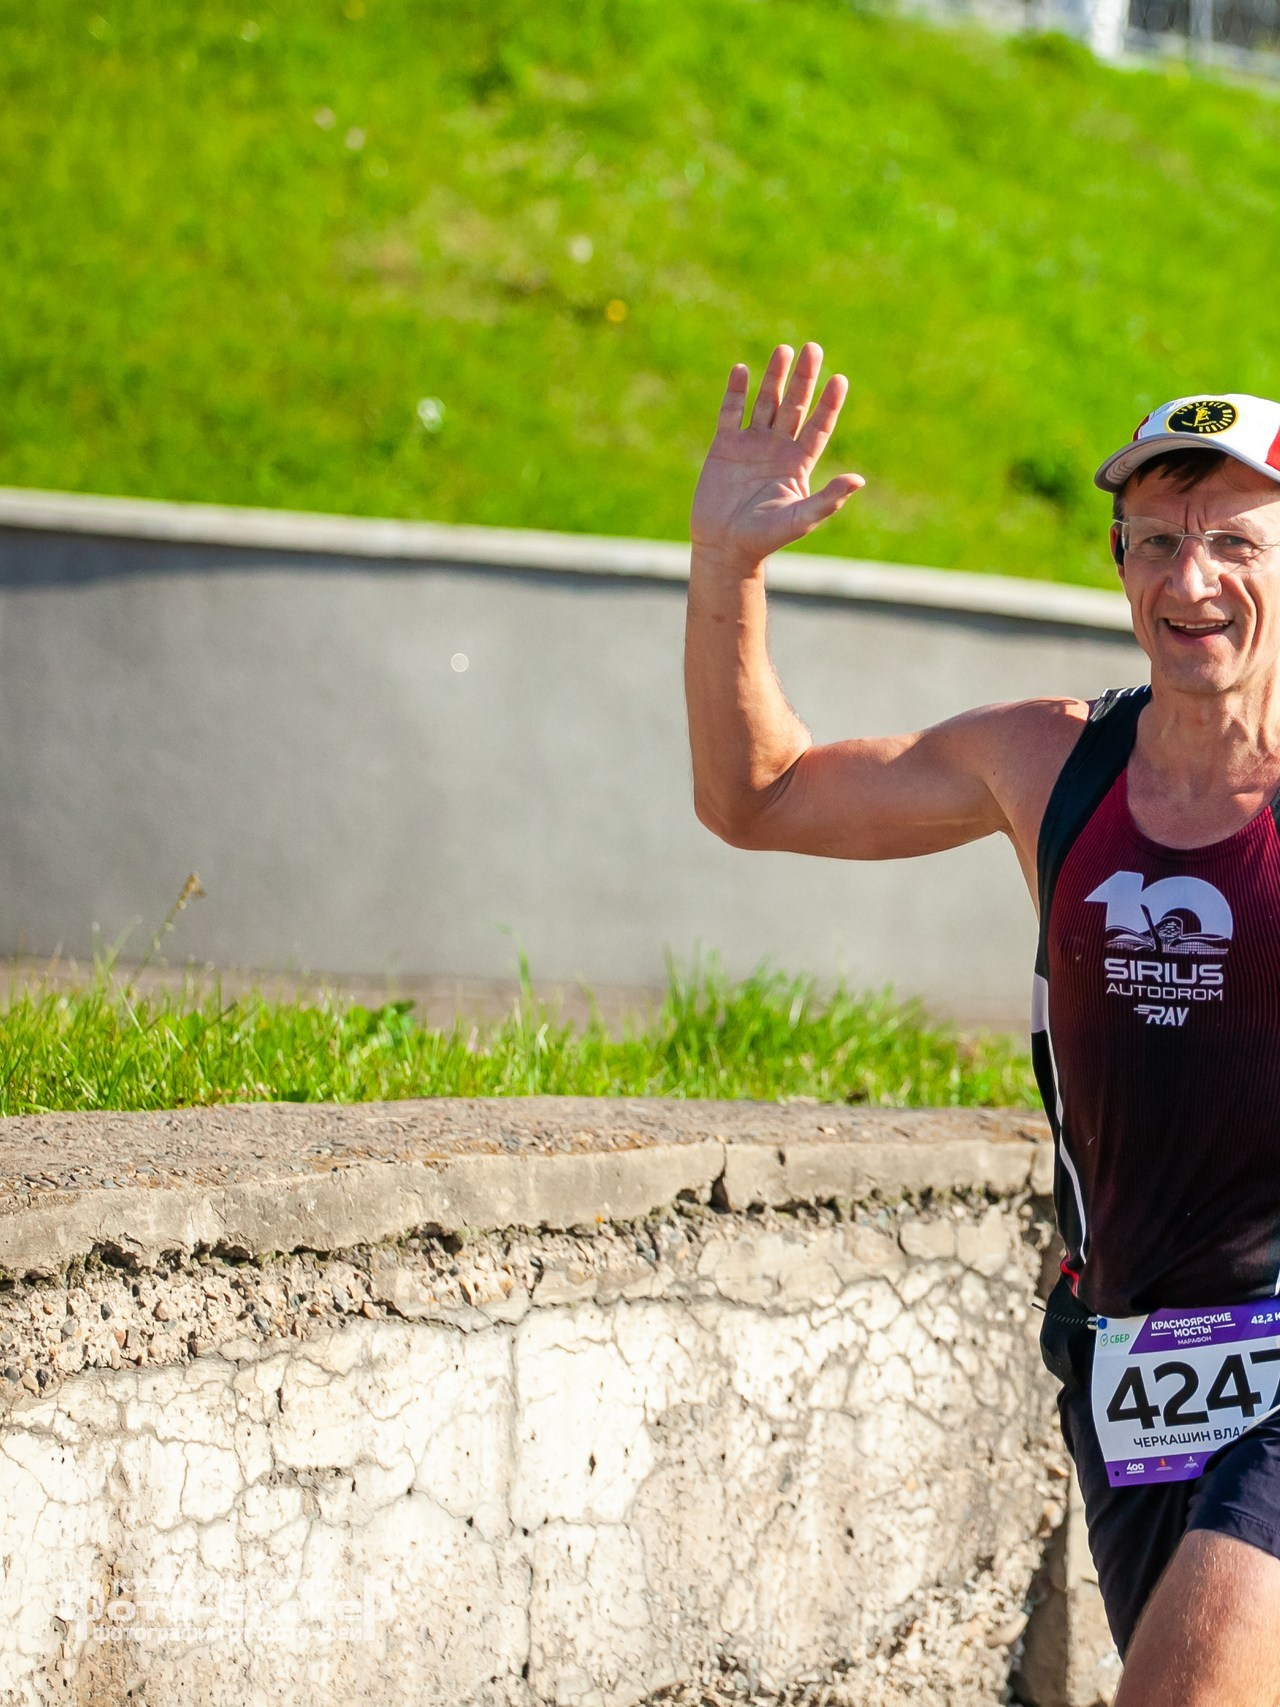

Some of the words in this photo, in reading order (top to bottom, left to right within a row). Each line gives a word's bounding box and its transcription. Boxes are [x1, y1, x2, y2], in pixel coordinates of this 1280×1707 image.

[1104, 957, 1224, 985] SIRIUS
[1105, 982, 1224, 1001] AUTODROM
[1133, 1003, 1190, 1027] RAY
[1150, 1312, 1233, 1331] КРАСНОЯРСКИЕ
[1250, 1312, 1274, 1325] 42,2
[1109, 1333, 1131, 1344] СБЕР
[1173, 1325, 1212, 1338] МОСТЫ
[1177, 1336, 1213, 1346] МАРАФОН
[1133, 1430, 1212, 1449] ЧЕРКАШИН
[1126, 1462, 1145, 1472] 400
